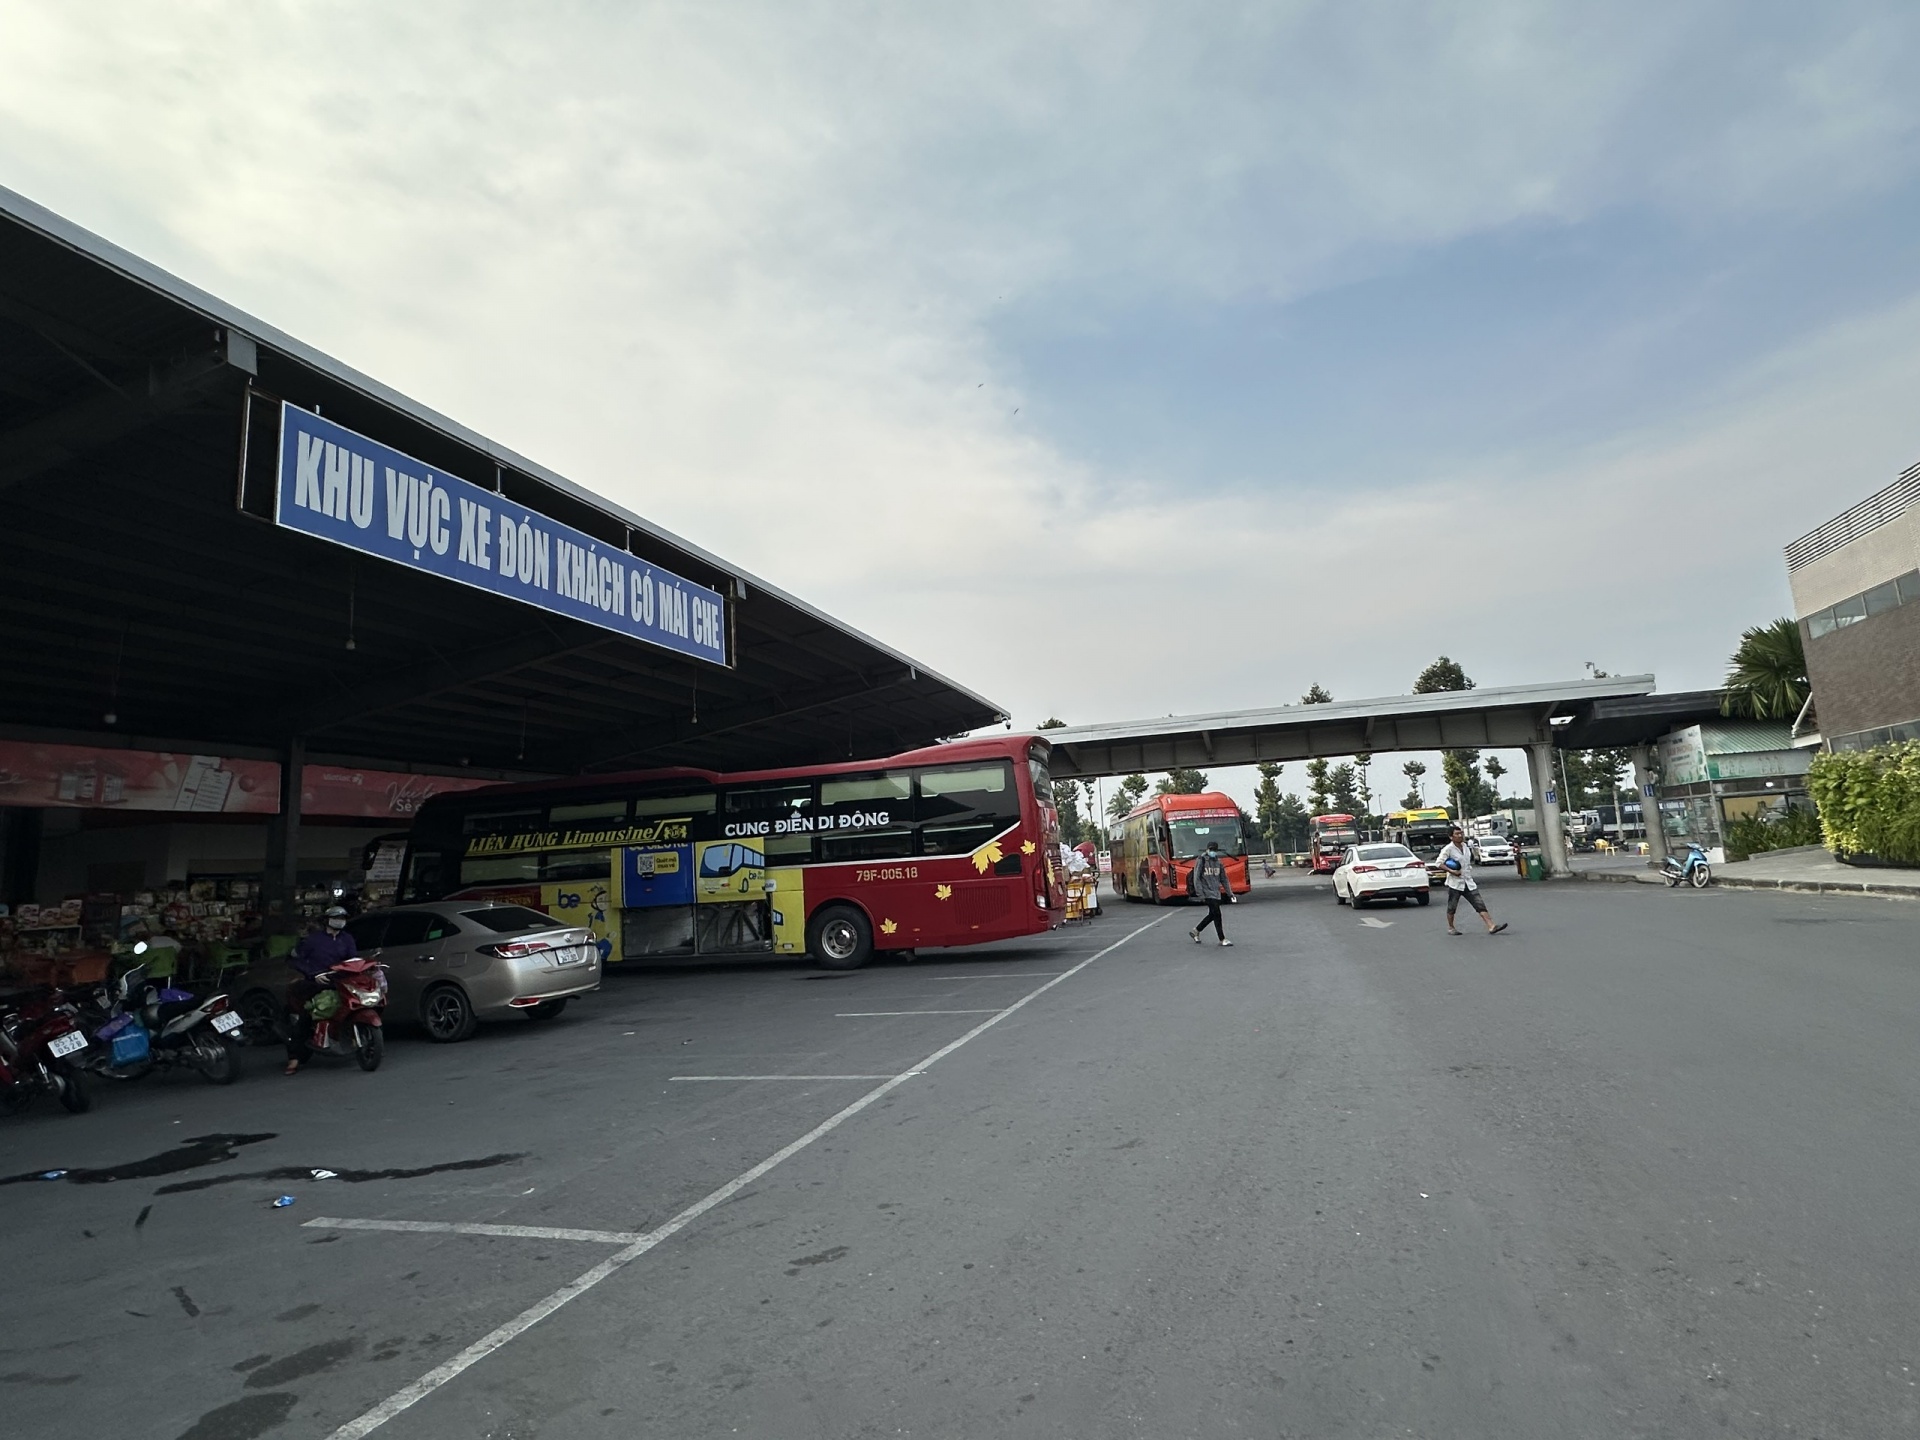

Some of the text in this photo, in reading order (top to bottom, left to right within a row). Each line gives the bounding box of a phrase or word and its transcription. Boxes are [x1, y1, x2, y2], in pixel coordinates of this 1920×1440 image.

[295, 429, 721, 651] KHU VỰC XE ĐÓN KHÁCH CÓ MÁI CHE
[725, 810, 890, 837] CUNG ĐIỆN DI ĐỘNG
[467, 825, 653, 852] LIÊN HƯNG Limousine
[856, 866, 918, 882] 79F-005.18
[558, 888, 580, 909] be
